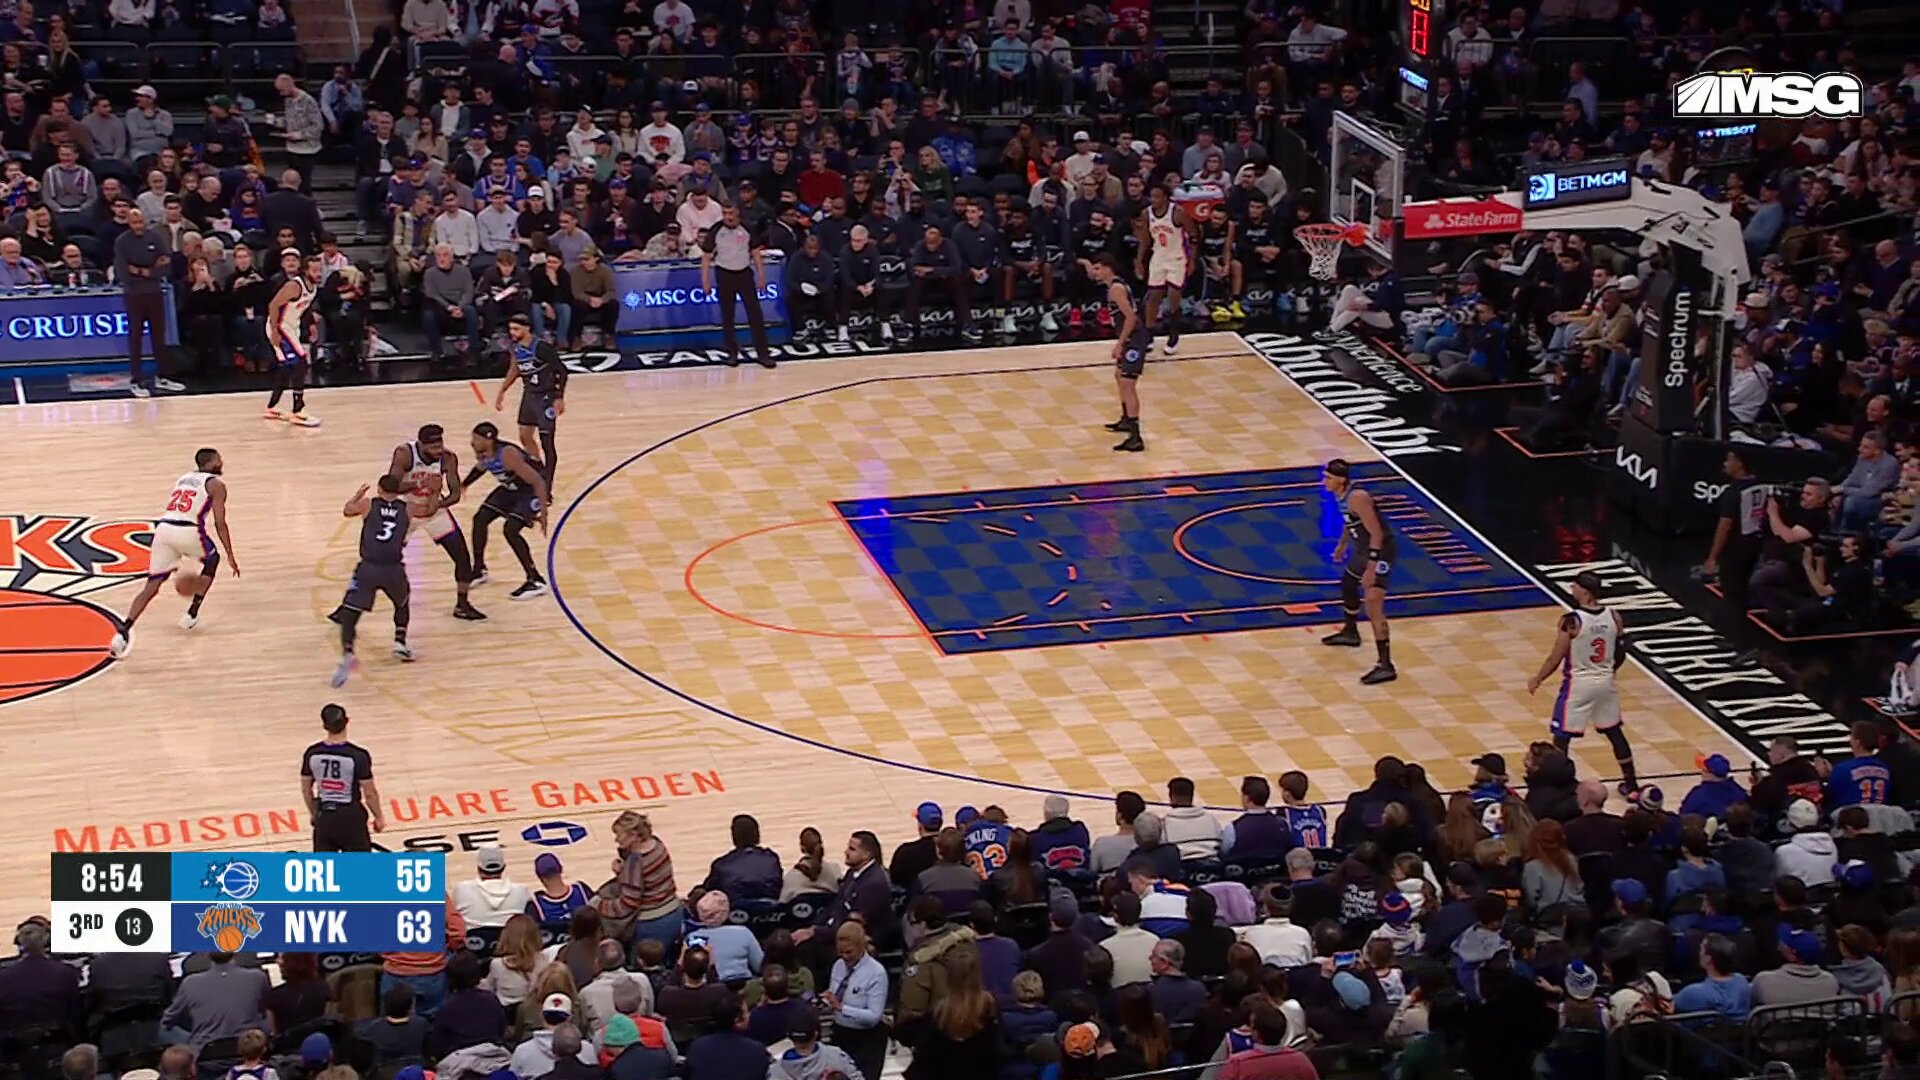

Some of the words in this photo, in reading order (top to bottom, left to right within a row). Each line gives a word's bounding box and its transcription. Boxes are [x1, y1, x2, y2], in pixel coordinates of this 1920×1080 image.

[1558, 171, 1628, 192] BETMGM
[1195, 203, 1210, 217] G
[645, 289, 686, 307] MSC
[9, 312, 149, 339] CRUISE
[920, 310, 954, 322] KIA
[1664, 291, 1692, 388] Spectrum
[530, 374, 539, 385] 4
[1616, 445, 1658, 489] KIA
[166, 489, 197, 513] 25
[376, 521, 397, 540] 3
[1589, 639, 1607, 664] 3
[320, 758, 341, 779] 78
[54, 809, 300, 853] MADISON
[389, 788, 518, 823] UARE
[530, 769, 726, 809] GARDEN
[1302, 828, 1321, 848] 11
